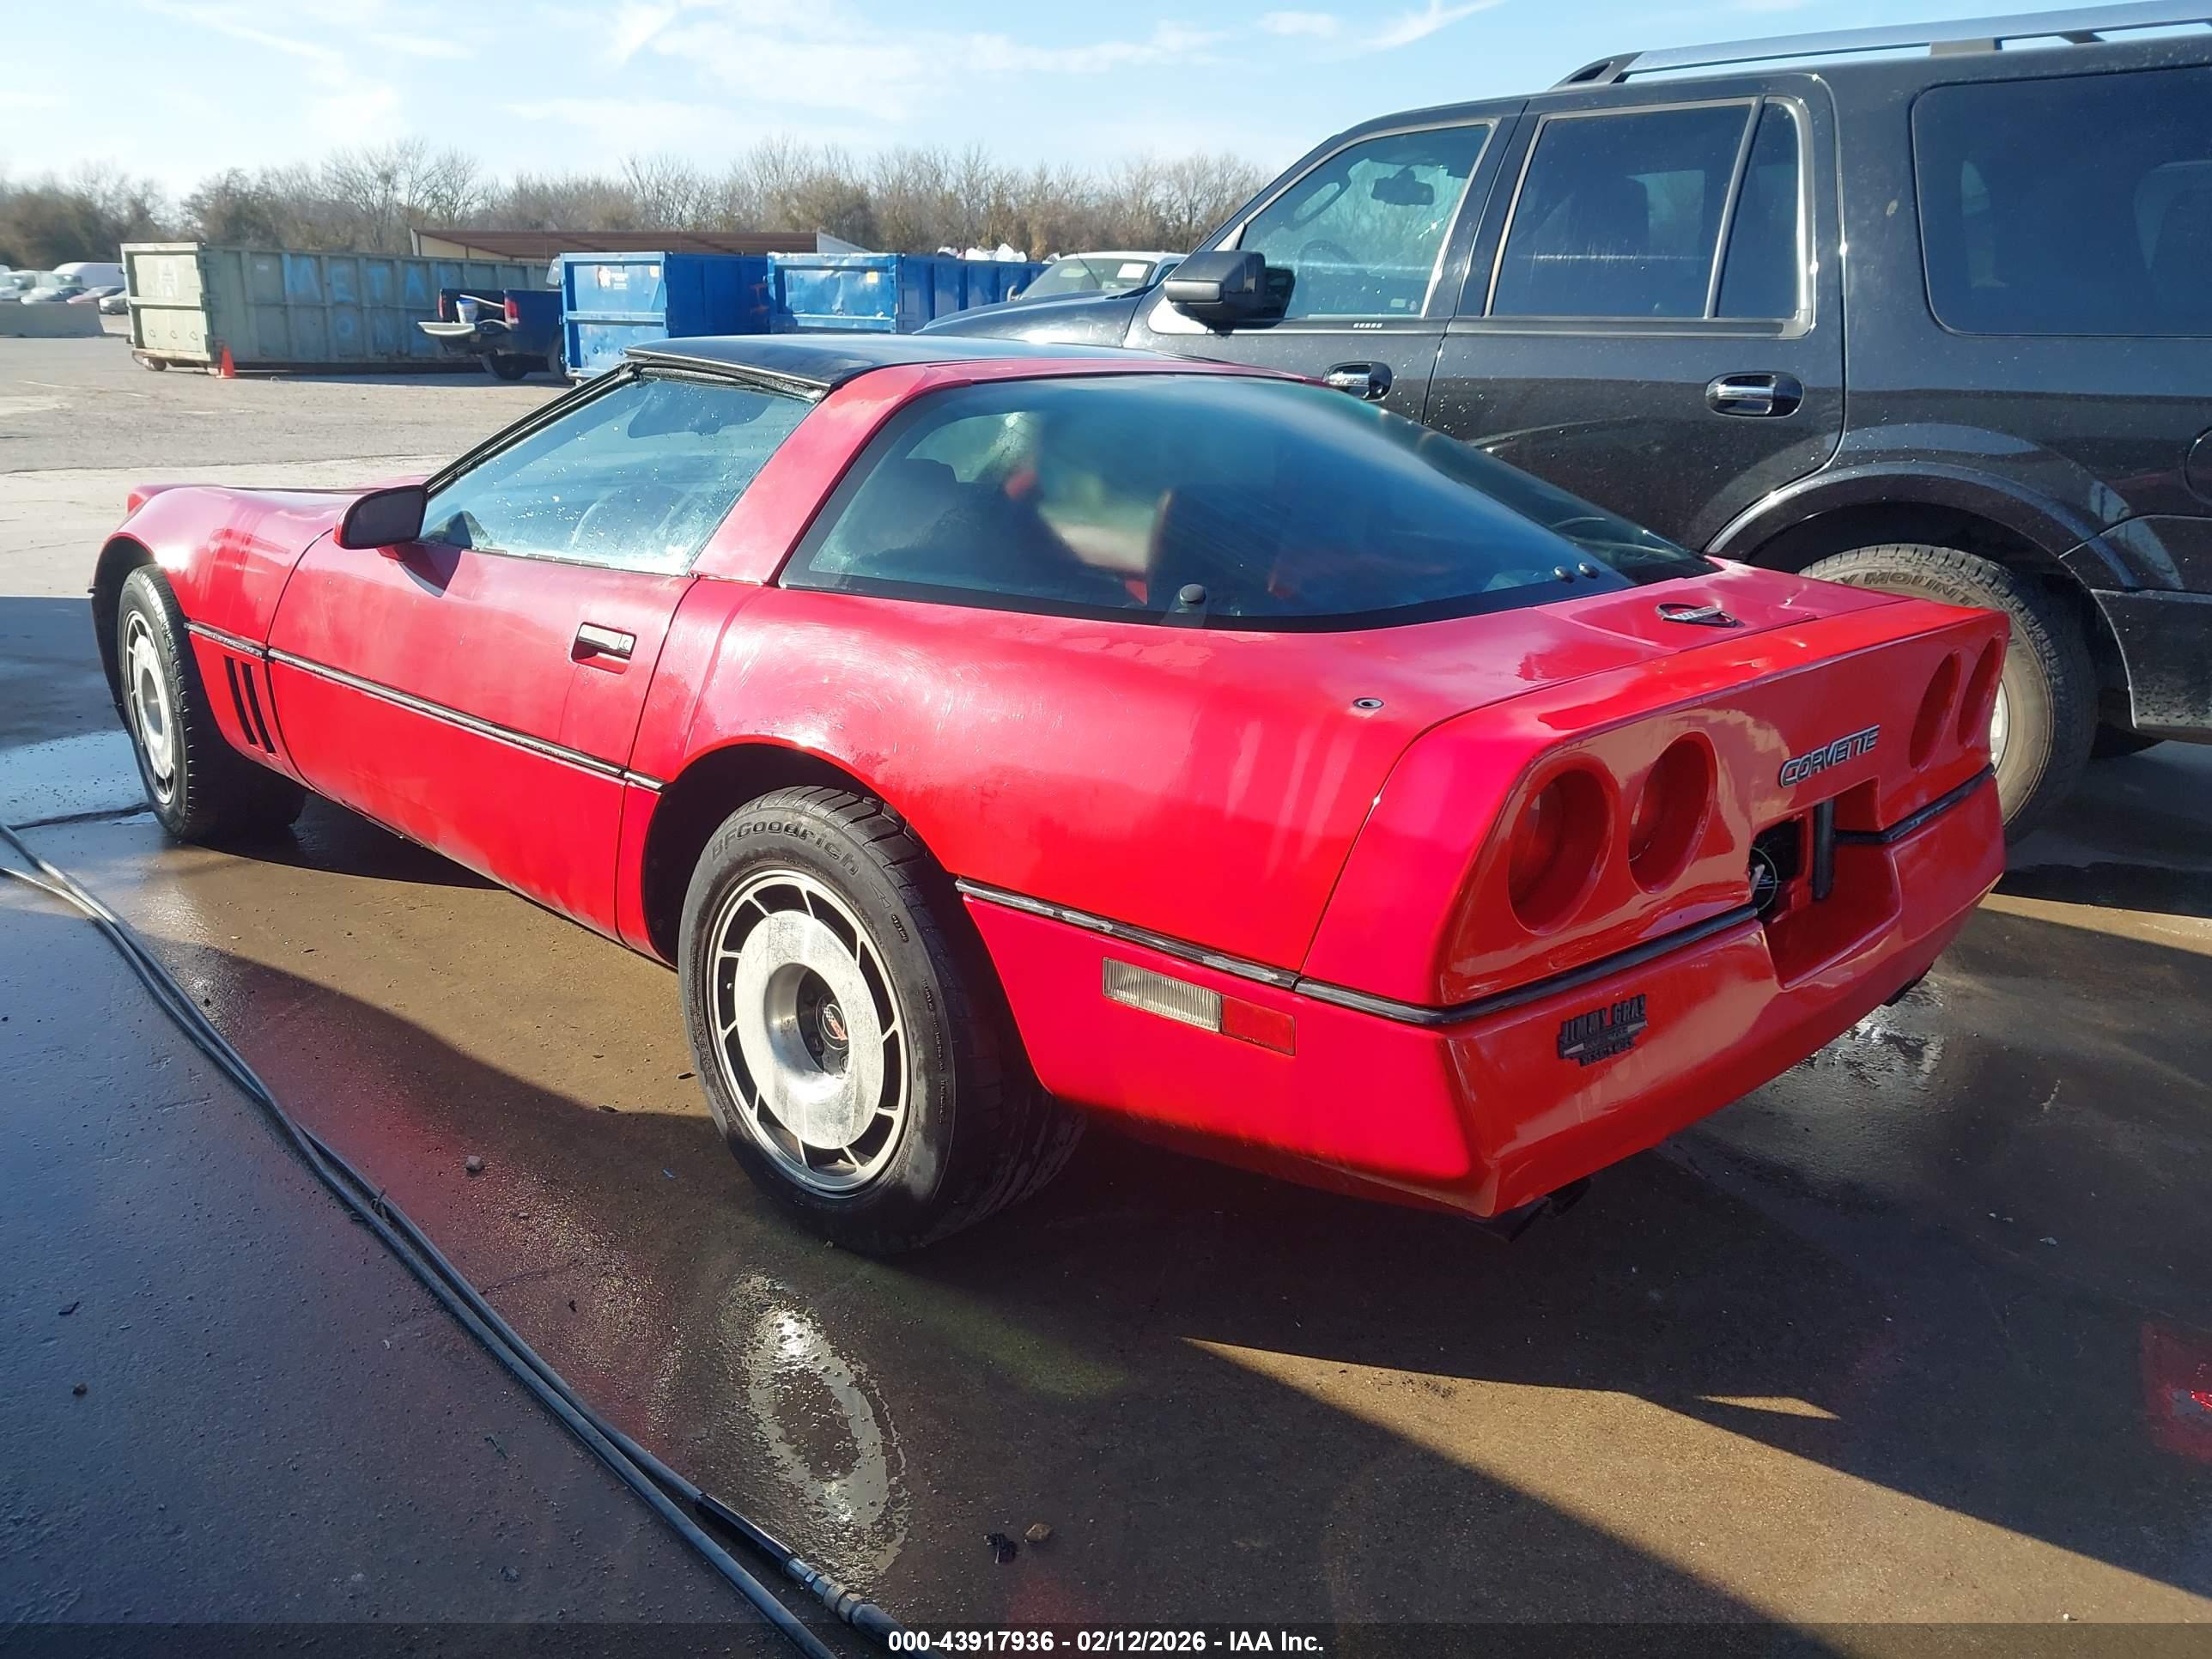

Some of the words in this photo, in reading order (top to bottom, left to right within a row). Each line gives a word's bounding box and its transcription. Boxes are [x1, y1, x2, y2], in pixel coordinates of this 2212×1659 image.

[1863, 572, 1981, 607] MOUNT
[1779, 725, 1881, 787] CORVETTE
[712, 820, 859, 876] BFGoodrich
